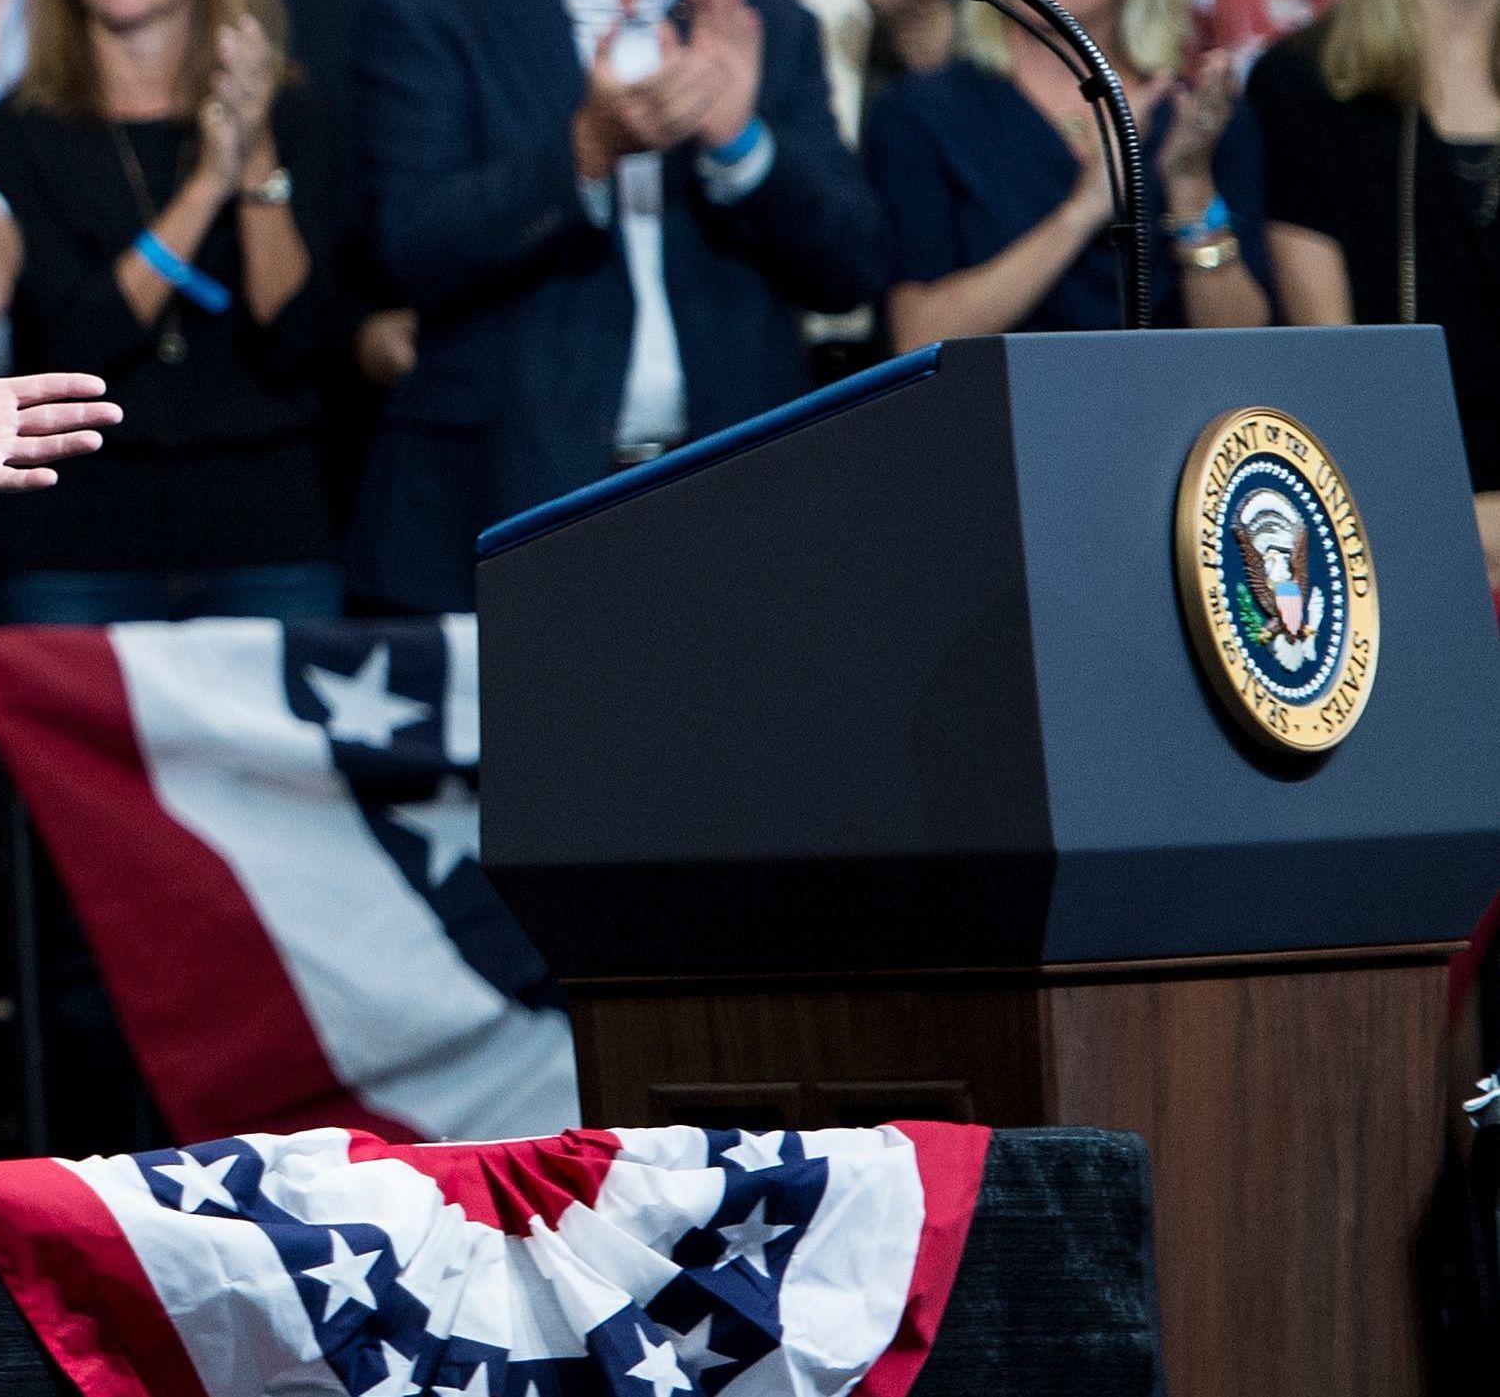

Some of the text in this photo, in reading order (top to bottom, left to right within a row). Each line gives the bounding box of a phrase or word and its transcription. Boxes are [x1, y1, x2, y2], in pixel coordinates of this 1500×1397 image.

[1201, 420, 1259, 570] PRESIDENT
[1316, 459, 1370, 598] UNITED
[1319, 630, 1370, 734] STATES
